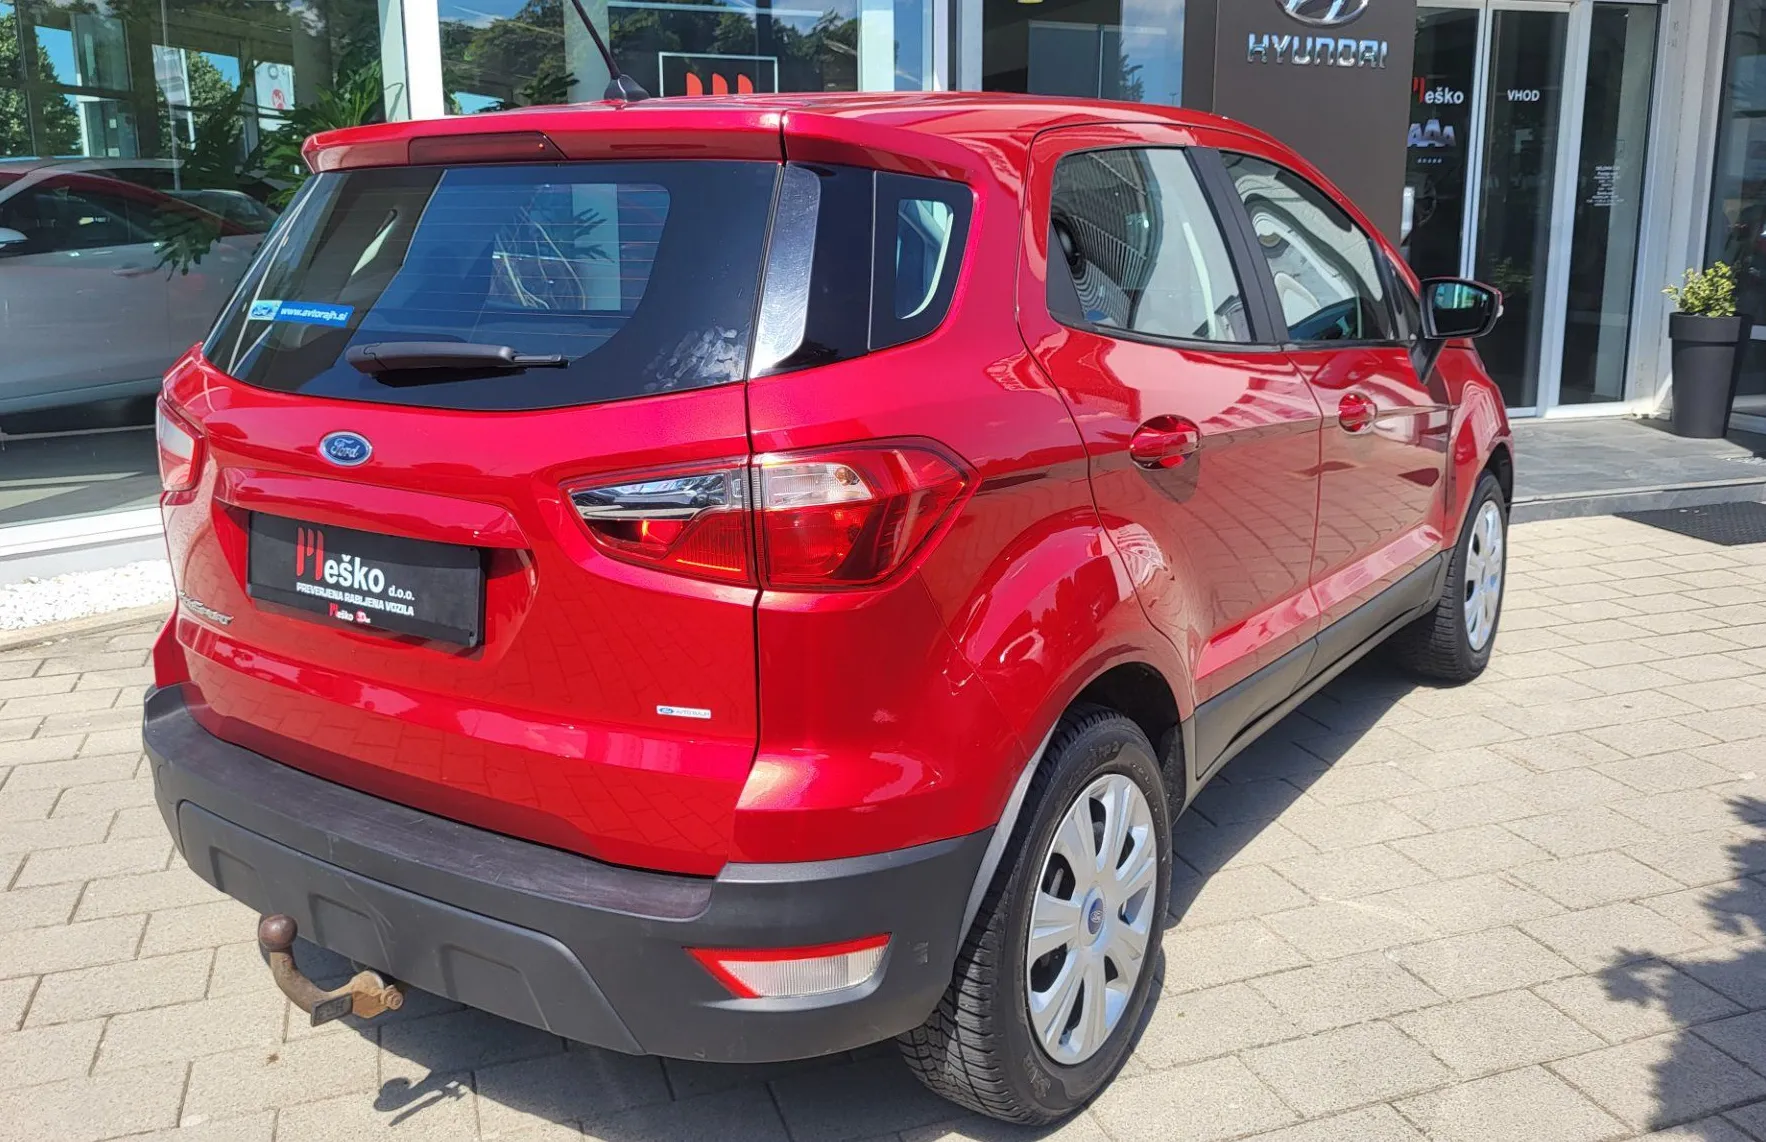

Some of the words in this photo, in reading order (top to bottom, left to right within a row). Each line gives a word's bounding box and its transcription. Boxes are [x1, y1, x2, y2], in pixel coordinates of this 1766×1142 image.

[1247, 32, 1388, 69] HYUNDAI
[1507, 89, 1540, 102] VHOD
[296, 527, 385, 593] Meško
[388, 584, 415, 601] d.o.o.
[296, 582, 344, 602] PREVERJENA
[344, 592, 385, 610] RABLJENA
[385, 601, 415, 616] VOZILA
